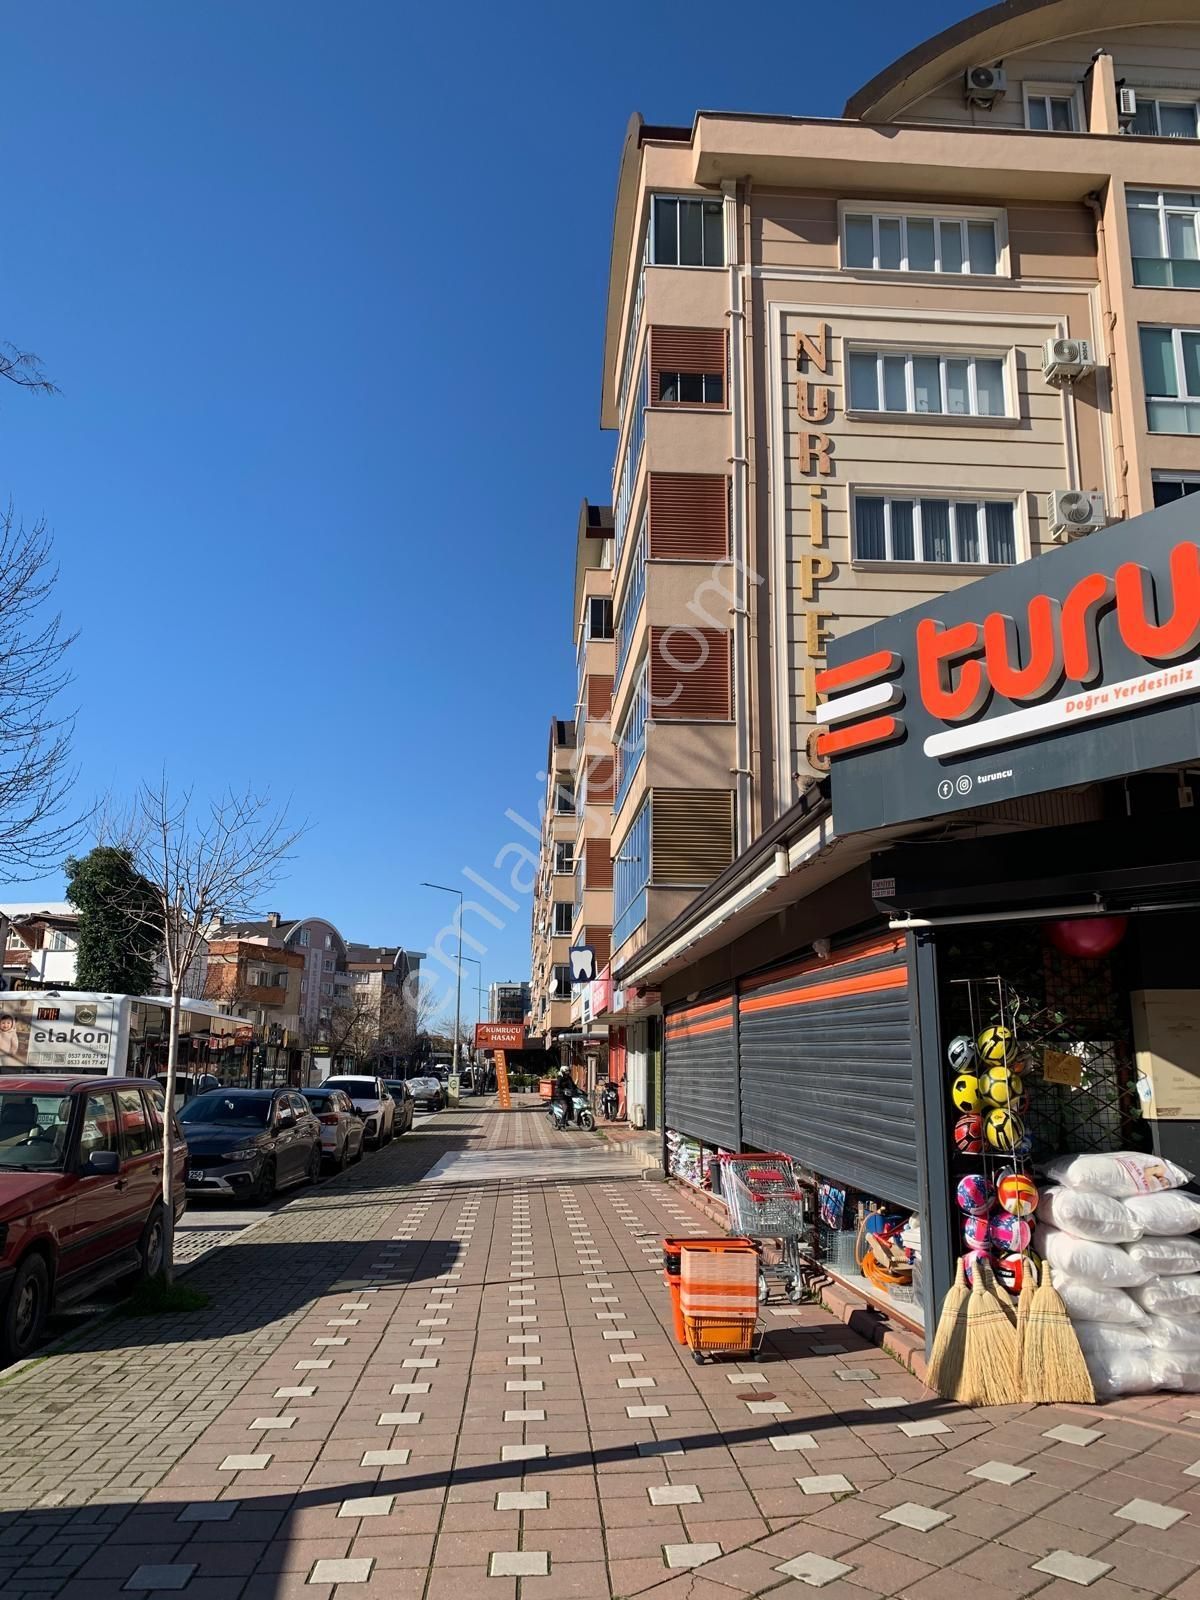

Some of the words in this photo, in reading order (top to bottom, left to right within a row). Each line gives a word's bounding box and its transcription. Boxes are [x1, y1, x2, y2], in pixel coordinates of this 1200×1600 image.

[1066, 690, 1109, 713] Doğru
[1113, 668, 1193, 700] Yerdesiniz
[977, 769, 1013, 784] turuncu
[34, 1029, 109, 1044] elakon
